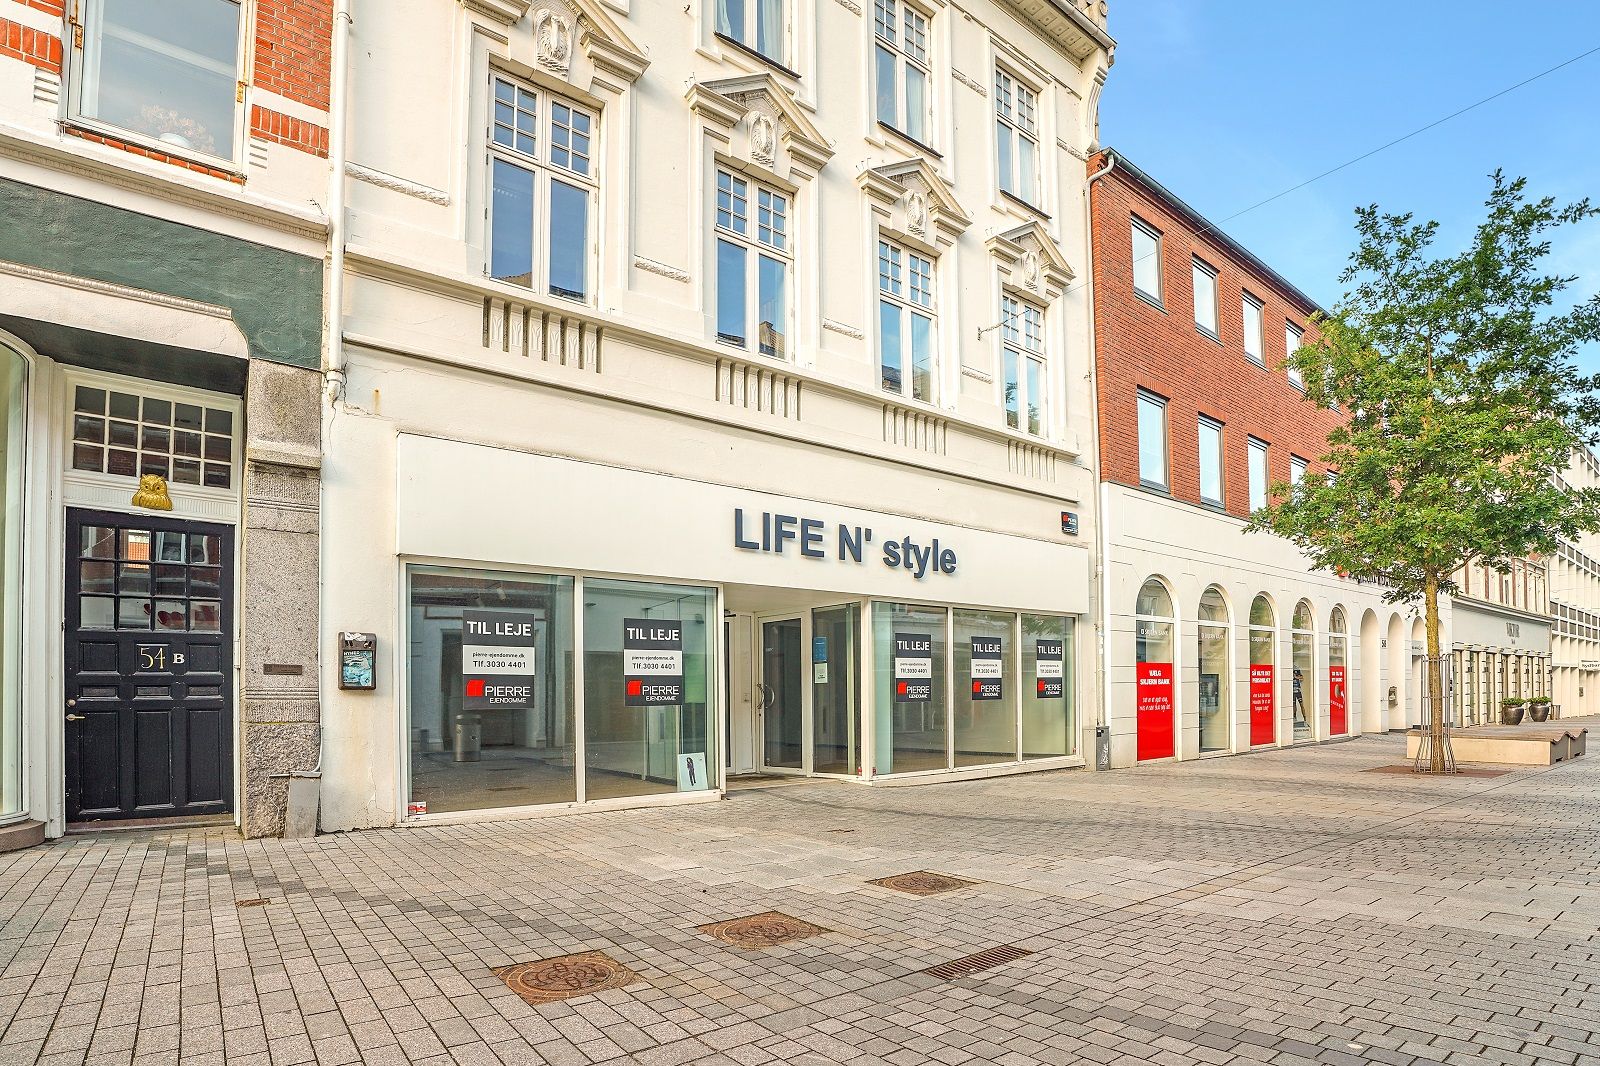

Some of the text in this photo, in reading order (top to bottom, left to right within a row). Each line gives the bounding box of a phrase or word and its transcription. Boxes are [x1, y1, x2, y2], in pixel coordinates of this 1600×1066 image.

[735, 508, 957, 579] LIFE N' style
[466, 620, 532, 637] TIL LEJE
[626, 627, 680, 641] TIL LEJE
[897, 640, 930, 651] TIL LEJE
[972, 643, 1001, 653] TIL LEJE
[1037, 645, 1062, 655] TIL LEJE
[140, 647, 186, 670] 54 B
[507, 661, 526, 669] 4401
[484, 685, 531, 697] PIERRE
[642, 685, 680, 696] PIERRE
[906, 685, 930, 694] PIERRE
[980, 684, 1001, 693] PIERRE
